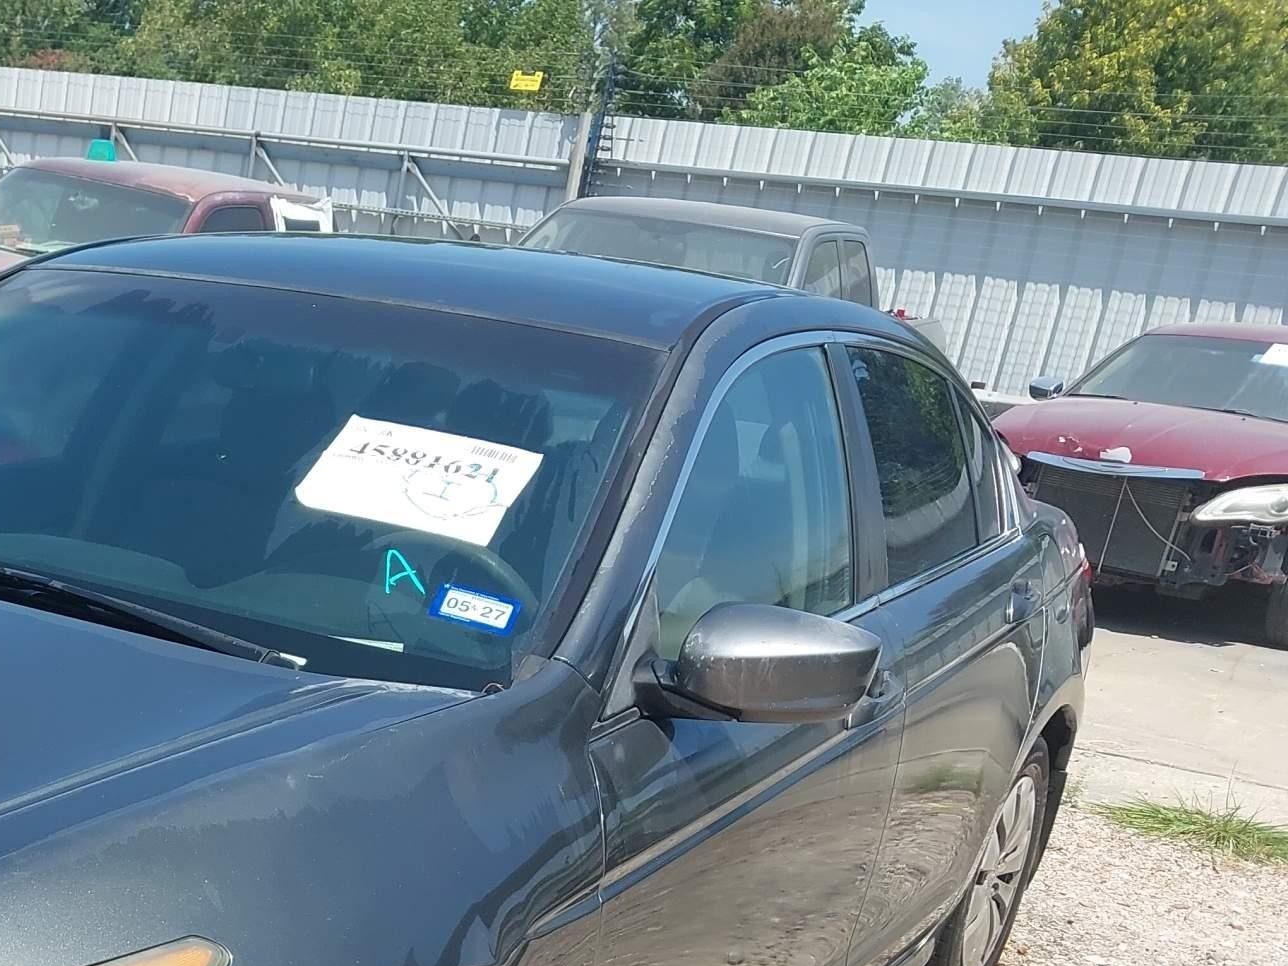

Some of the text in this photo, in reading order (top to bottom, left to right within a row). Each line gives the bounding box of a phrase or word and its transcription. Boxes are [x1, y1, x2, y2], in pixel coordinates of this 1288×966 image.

[385, 549, 426, 596] A
[446, 597, 472, 613] 05
[479, 606, 507, 621] 27
